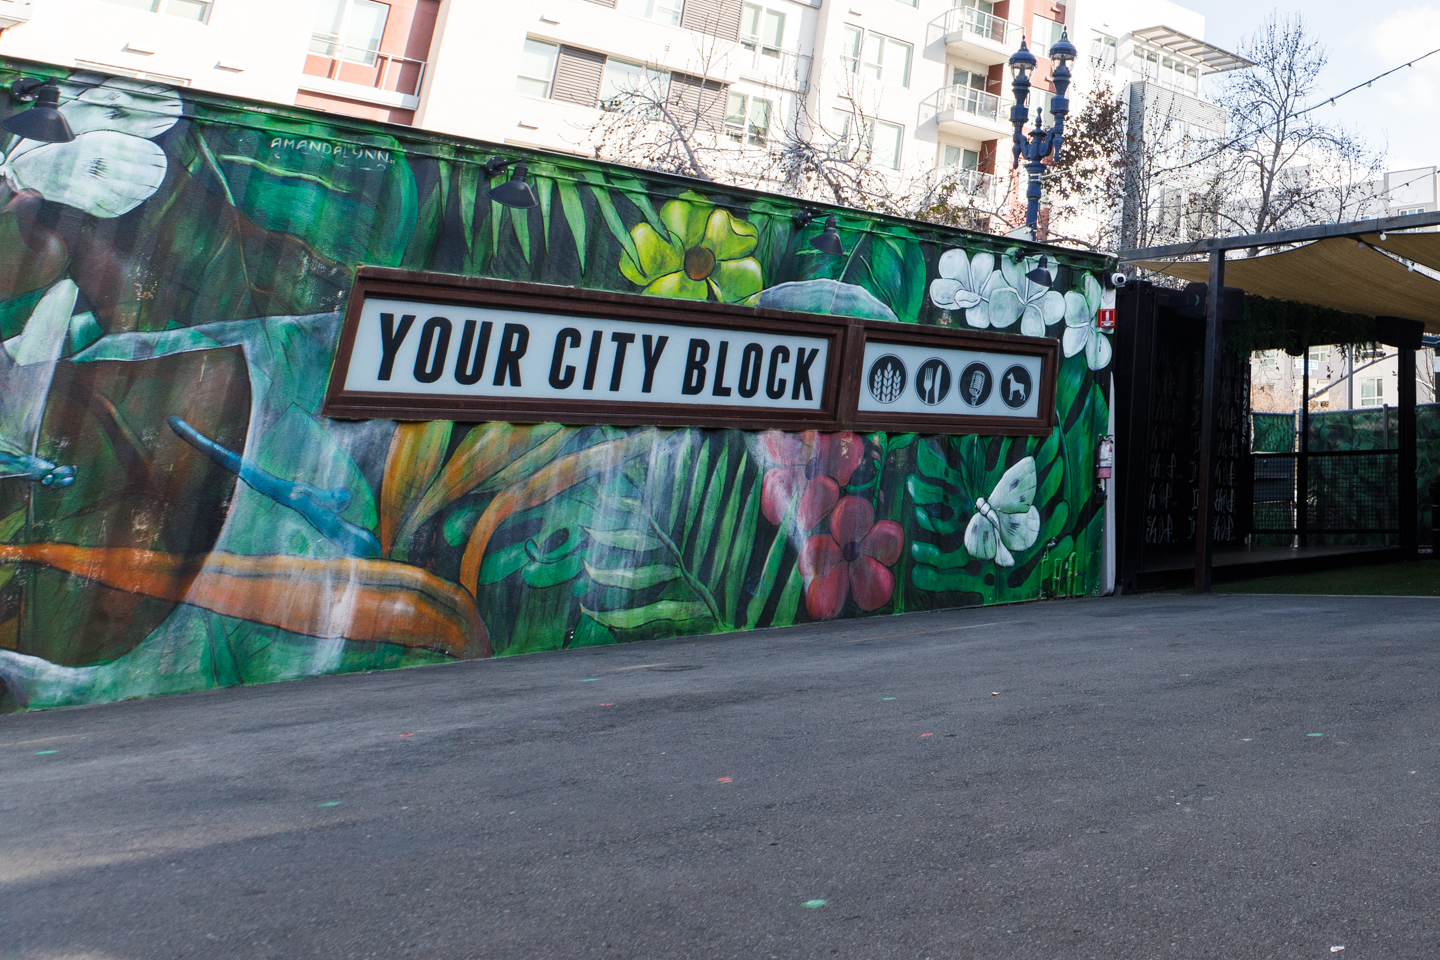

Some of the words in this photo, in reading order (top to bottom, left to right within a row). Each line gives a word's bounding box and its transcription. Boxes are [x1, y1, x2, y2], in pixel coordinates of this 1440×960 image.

[376, 312, 531, 388] YOUR
[548, 327, 670, 394] CITY
[681, 337, 820, 401] BLOCK
